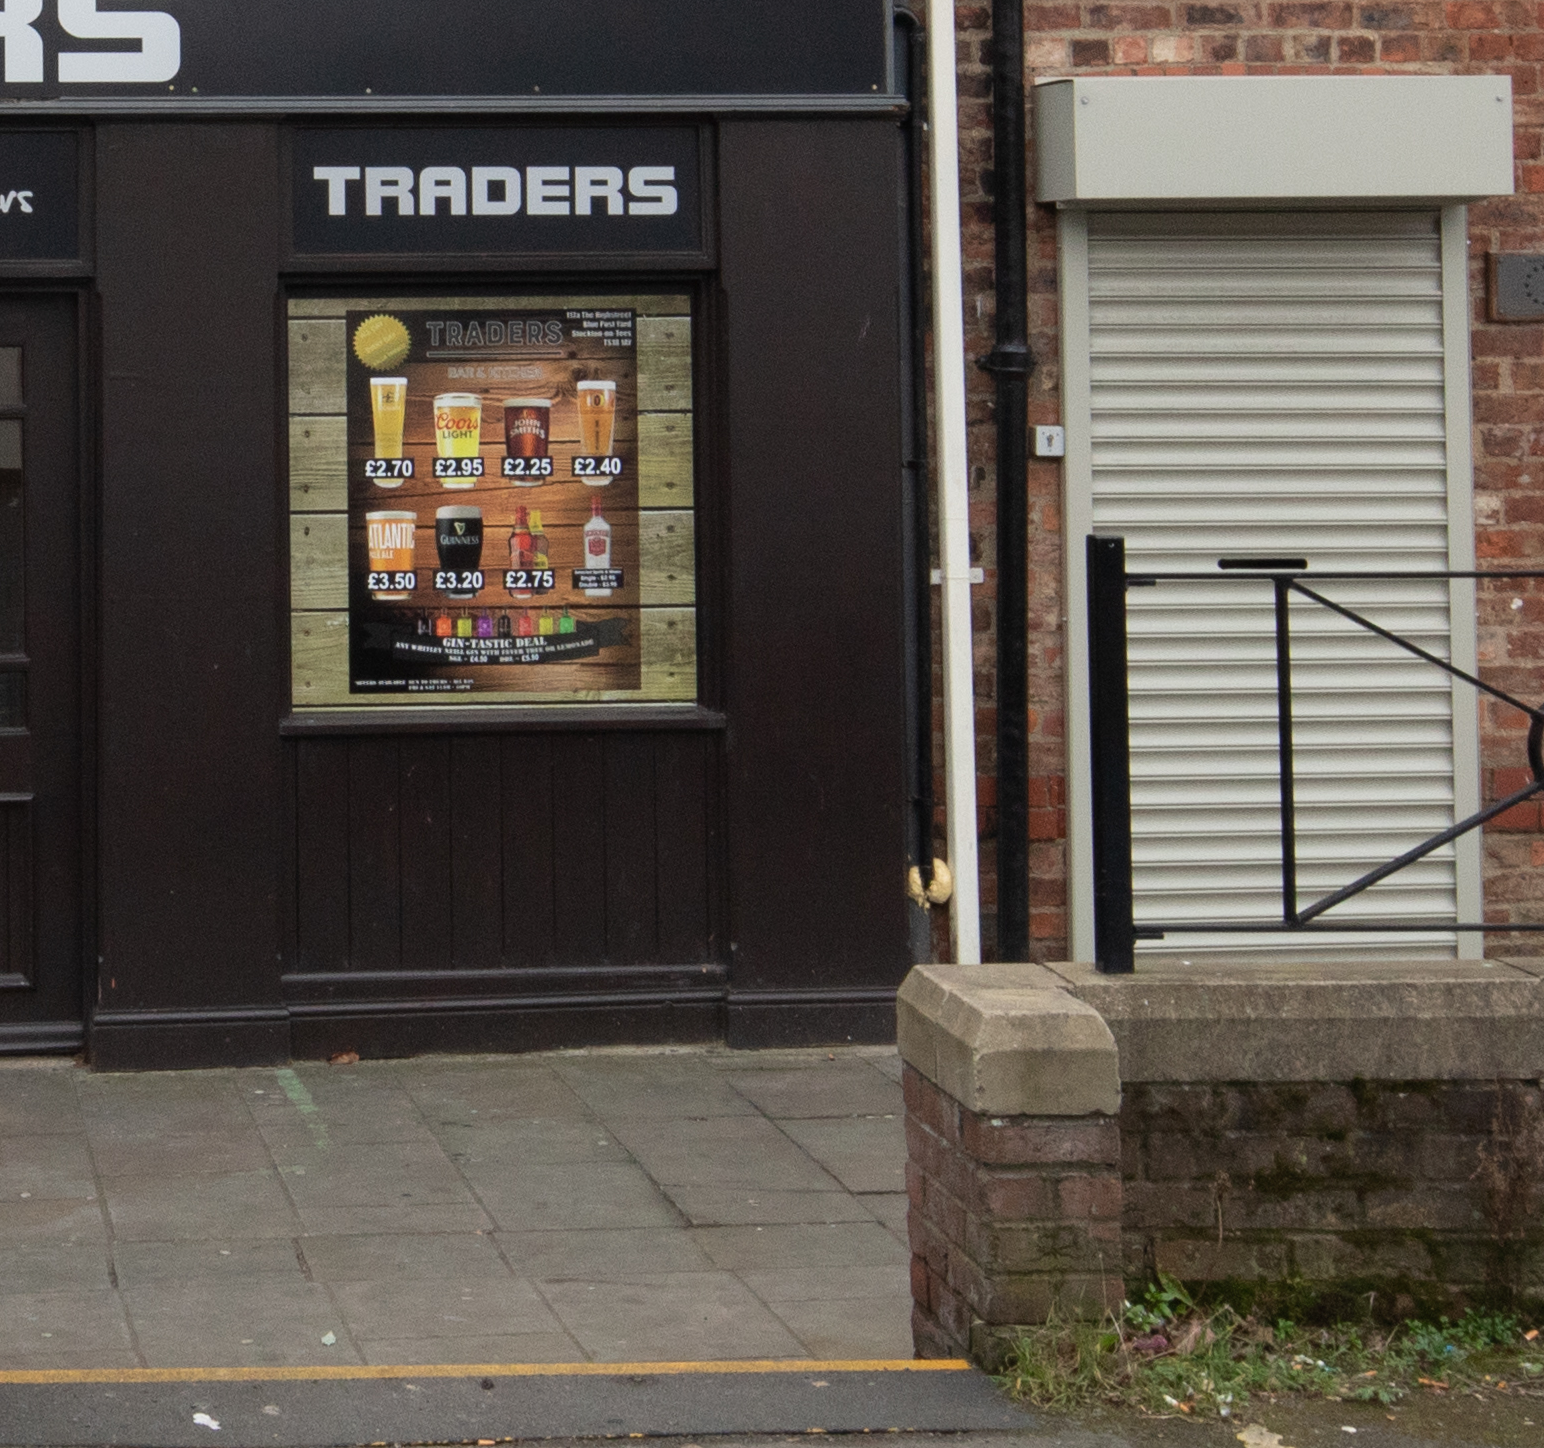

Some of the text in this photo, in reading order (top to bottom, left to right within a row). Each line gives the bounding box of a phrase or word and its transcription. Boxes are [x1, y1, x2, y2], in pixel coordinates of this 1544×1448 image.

[313, 166, 678, 215] TRADERS
[426, 321, 563, 346] TRADERS
[436, 412, 478, 430] Coors
[514, 419, 540, 428] JOHN
[442, 430, 473, 439] LIGHT
[365, 460, 413, 477] £2.70
[435, 459, 483, 476] £2.95
[503, 458, 551, 475] £2.25
[574, 458, 622, 475] £2.40
[368, 523, 415, 549] ATLANTIC
[440, 534, 479, 545] GUINNESS
[368, 573, 415, 589] £3.50
[435, 571, 483, 588] £3.20
[505, 571, 553, 588] £2.75
[443, 636, 547, 649] GIN-TASTIC DEAL
